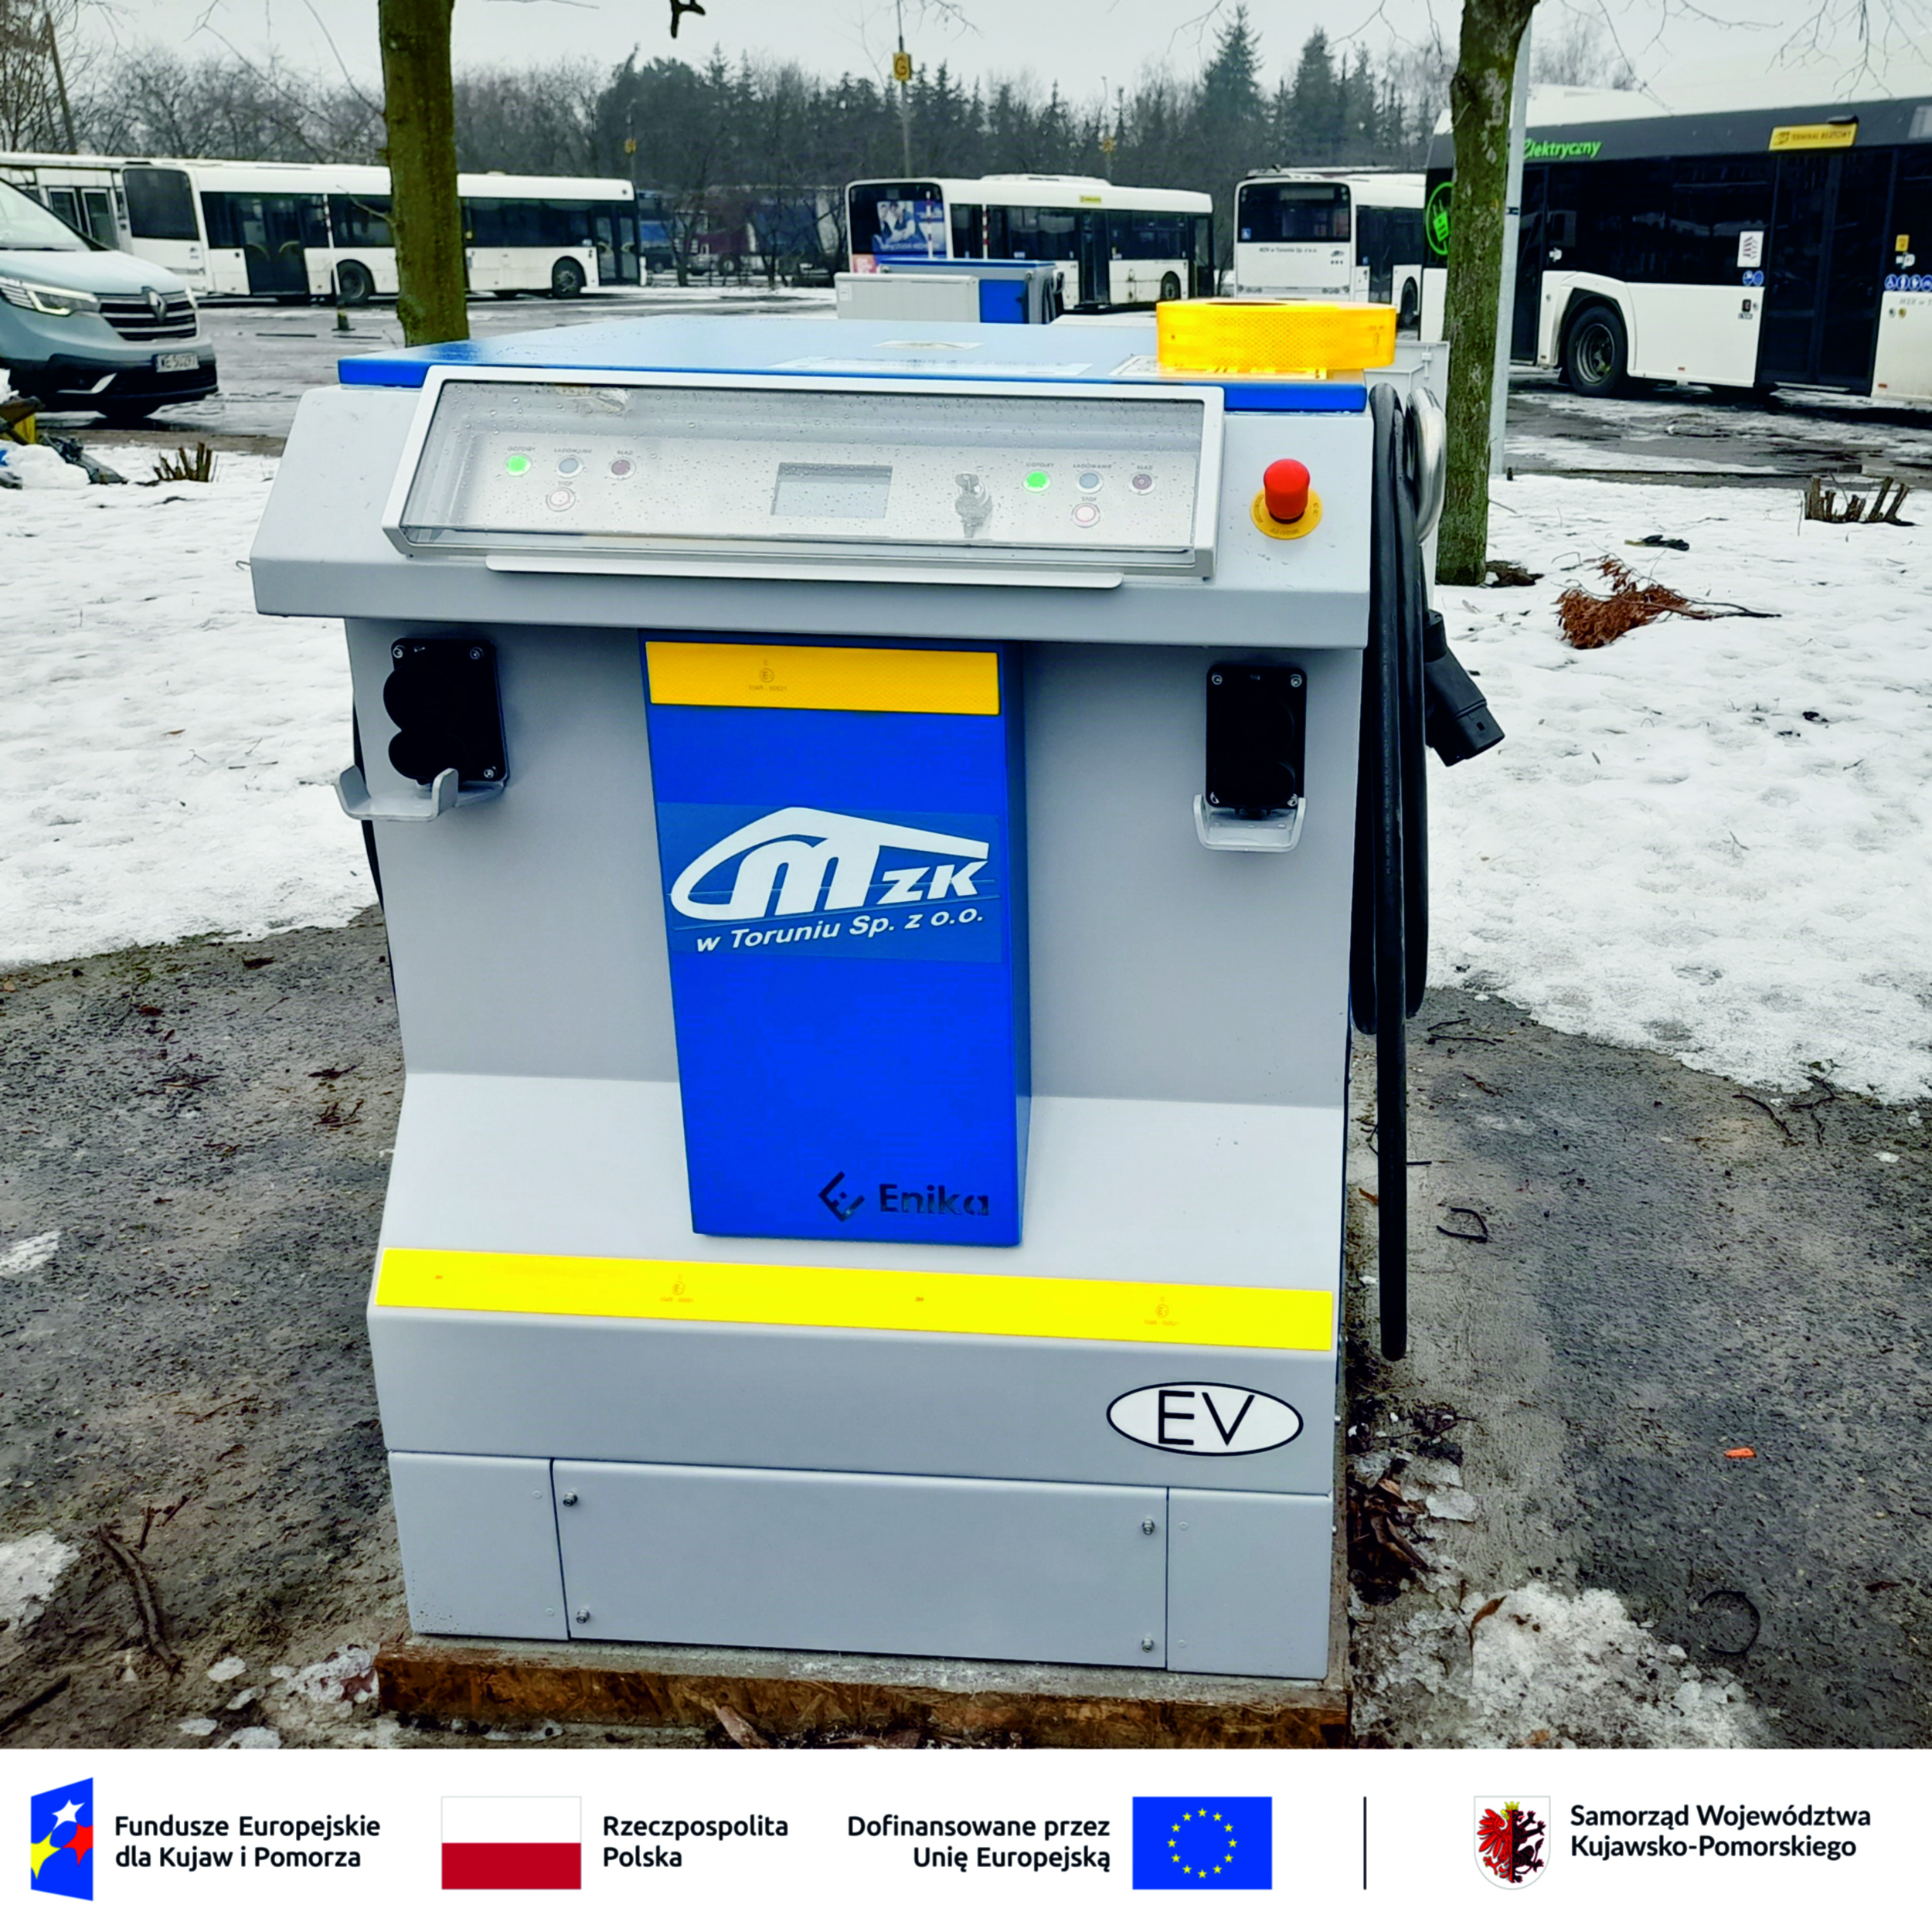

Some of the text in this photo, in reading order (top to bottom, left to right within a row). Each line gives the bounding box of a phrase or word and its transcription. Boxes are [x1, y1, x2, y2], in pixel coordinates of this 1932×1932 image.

[696, 908, 984, 952] w Toruniu Sp. z o.o.
[879, 1184, 989, 1216] Enika
[1158, 1389, 1256, 1447] EV
